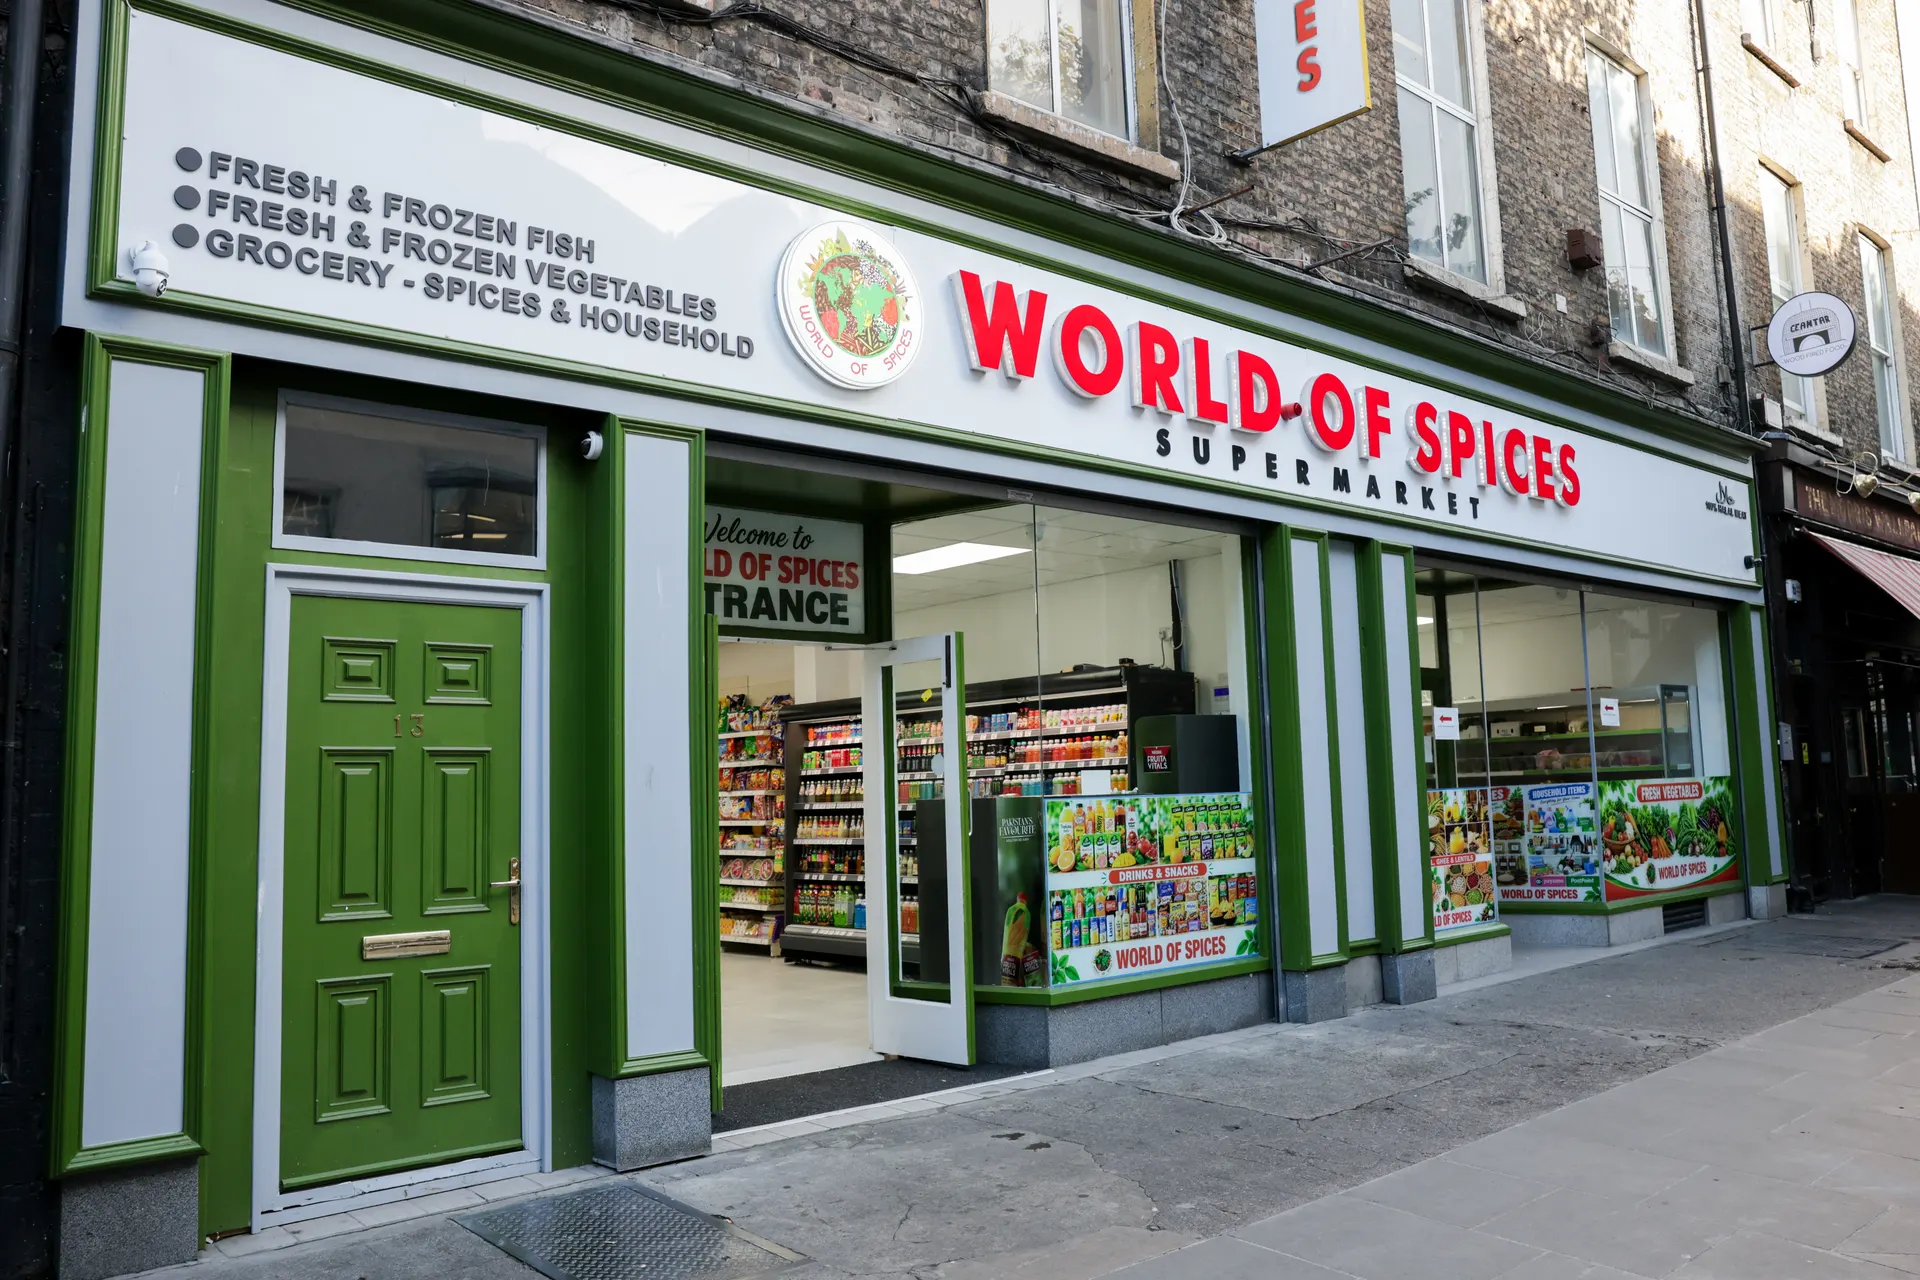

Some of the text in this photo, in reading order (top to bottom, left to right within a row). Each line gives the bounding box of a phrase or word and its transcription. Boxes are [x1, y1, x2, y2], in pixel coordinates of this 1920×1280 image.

[1295, 0, 1322, 92] ES
[209, 150, 595, 263] FRESH & FROZEN FISH
[208, 188, 718, 321] FRESH & FROZEN VEGETABLES
[205, 229, 395, 288] GROCERY
[423, 272, 542, 318] SPICES
[551, 297, 572, 324] &
[580, 303, 755, 359] HOUSEHOLD
[1790, 314, 1831, 333] CEANTAR
[799, 304, 913, 376] WORLD OF SPICES
[950, 269, 1581, 508] WORLD OF SPICES
[1156, 428, 1480, 520] SUPERMARKET
[793, 525, 815, 550] to
[739, 551, 772, 582] OF
[778, 555, 860, 590] SPICES
[393, 713, 425, 738] 13
[1532, 787, 1567, 799] HOUSEHOLD
[1641, 784, 1700, 801] FRESH VEGETABLES
[1454, 854, 1475, 863] LENTILS
[1658, 861, 1707, 880] WORLD OF SPICES
[1119, 865, 1199, 882] DRINKS & SNACKS
[1501, 889, 1578, 899] WORLD OF SPICES
[1443, 912, 1451, 928] OF
[1451, 910, 1473, 925] SPICES
[1116, 935, 1226, 970] WORLD OF SPICES
